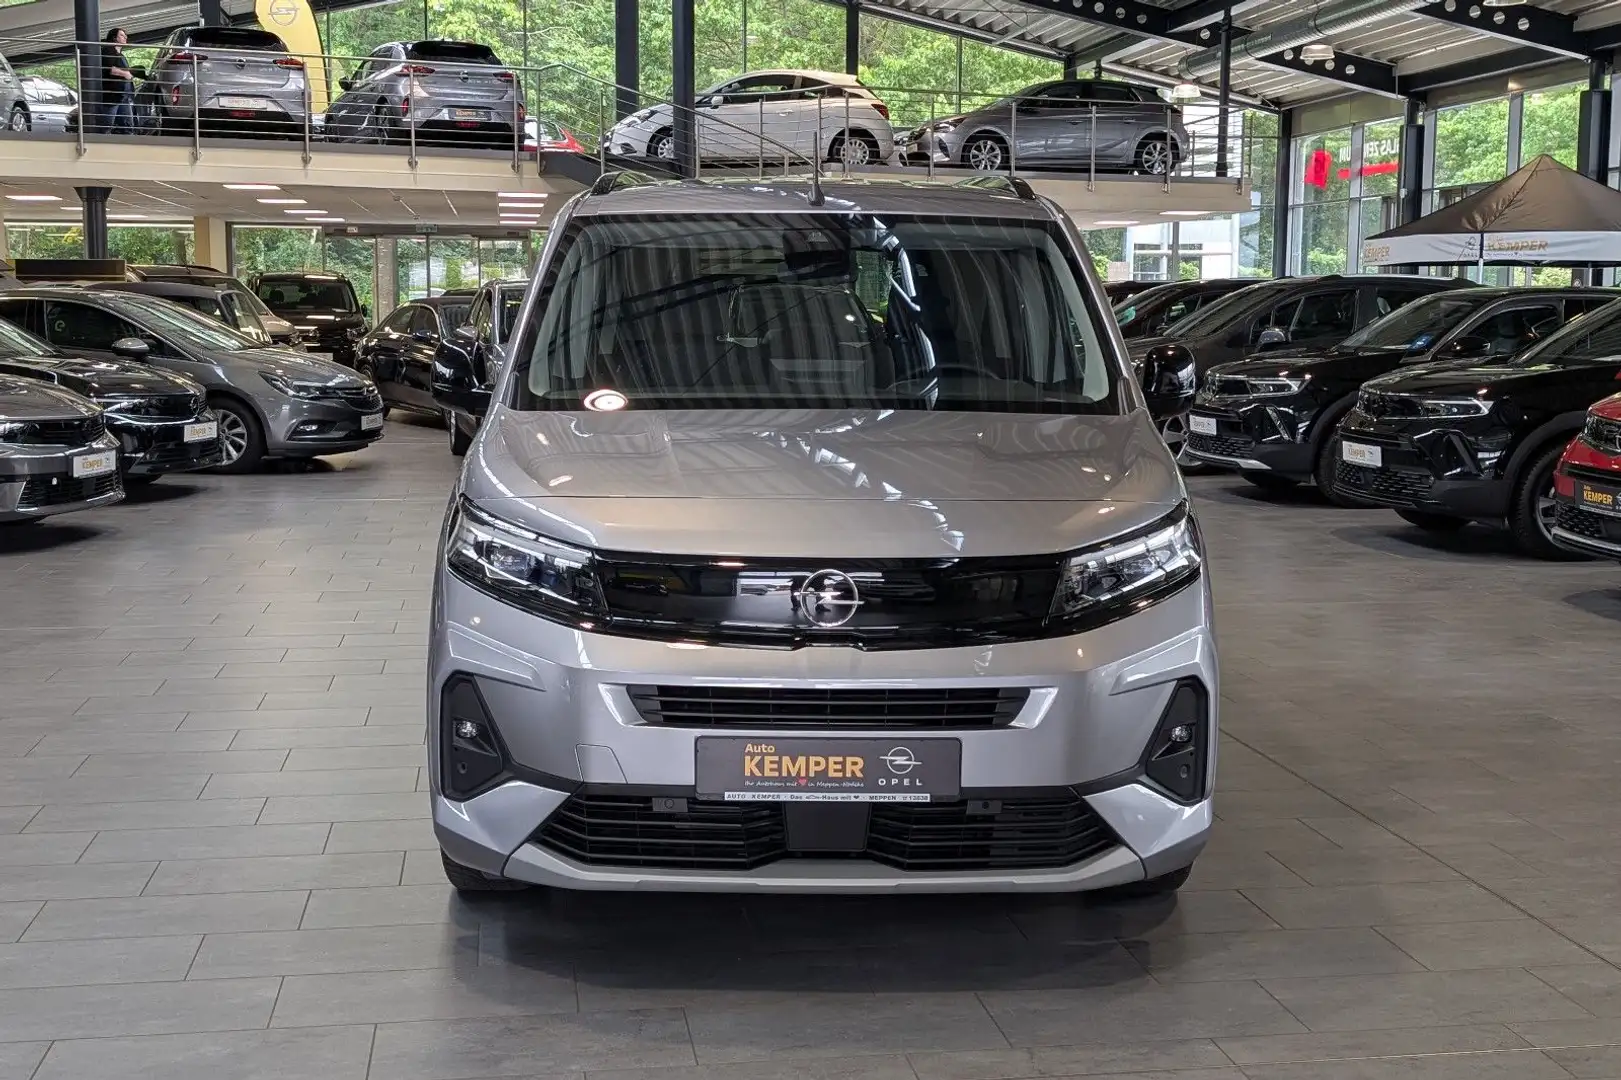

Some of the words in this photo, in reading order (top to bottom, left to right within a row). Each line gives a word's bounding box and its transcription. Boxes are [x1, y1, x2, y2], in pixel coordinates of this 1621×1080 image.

[1487, 240, 1548, 251] KEMPER
[1583, 490, 1613, 505] KEMPER
[744, 744, 775, 753] Auto
[744, 756, 864, 778] KEMPER
